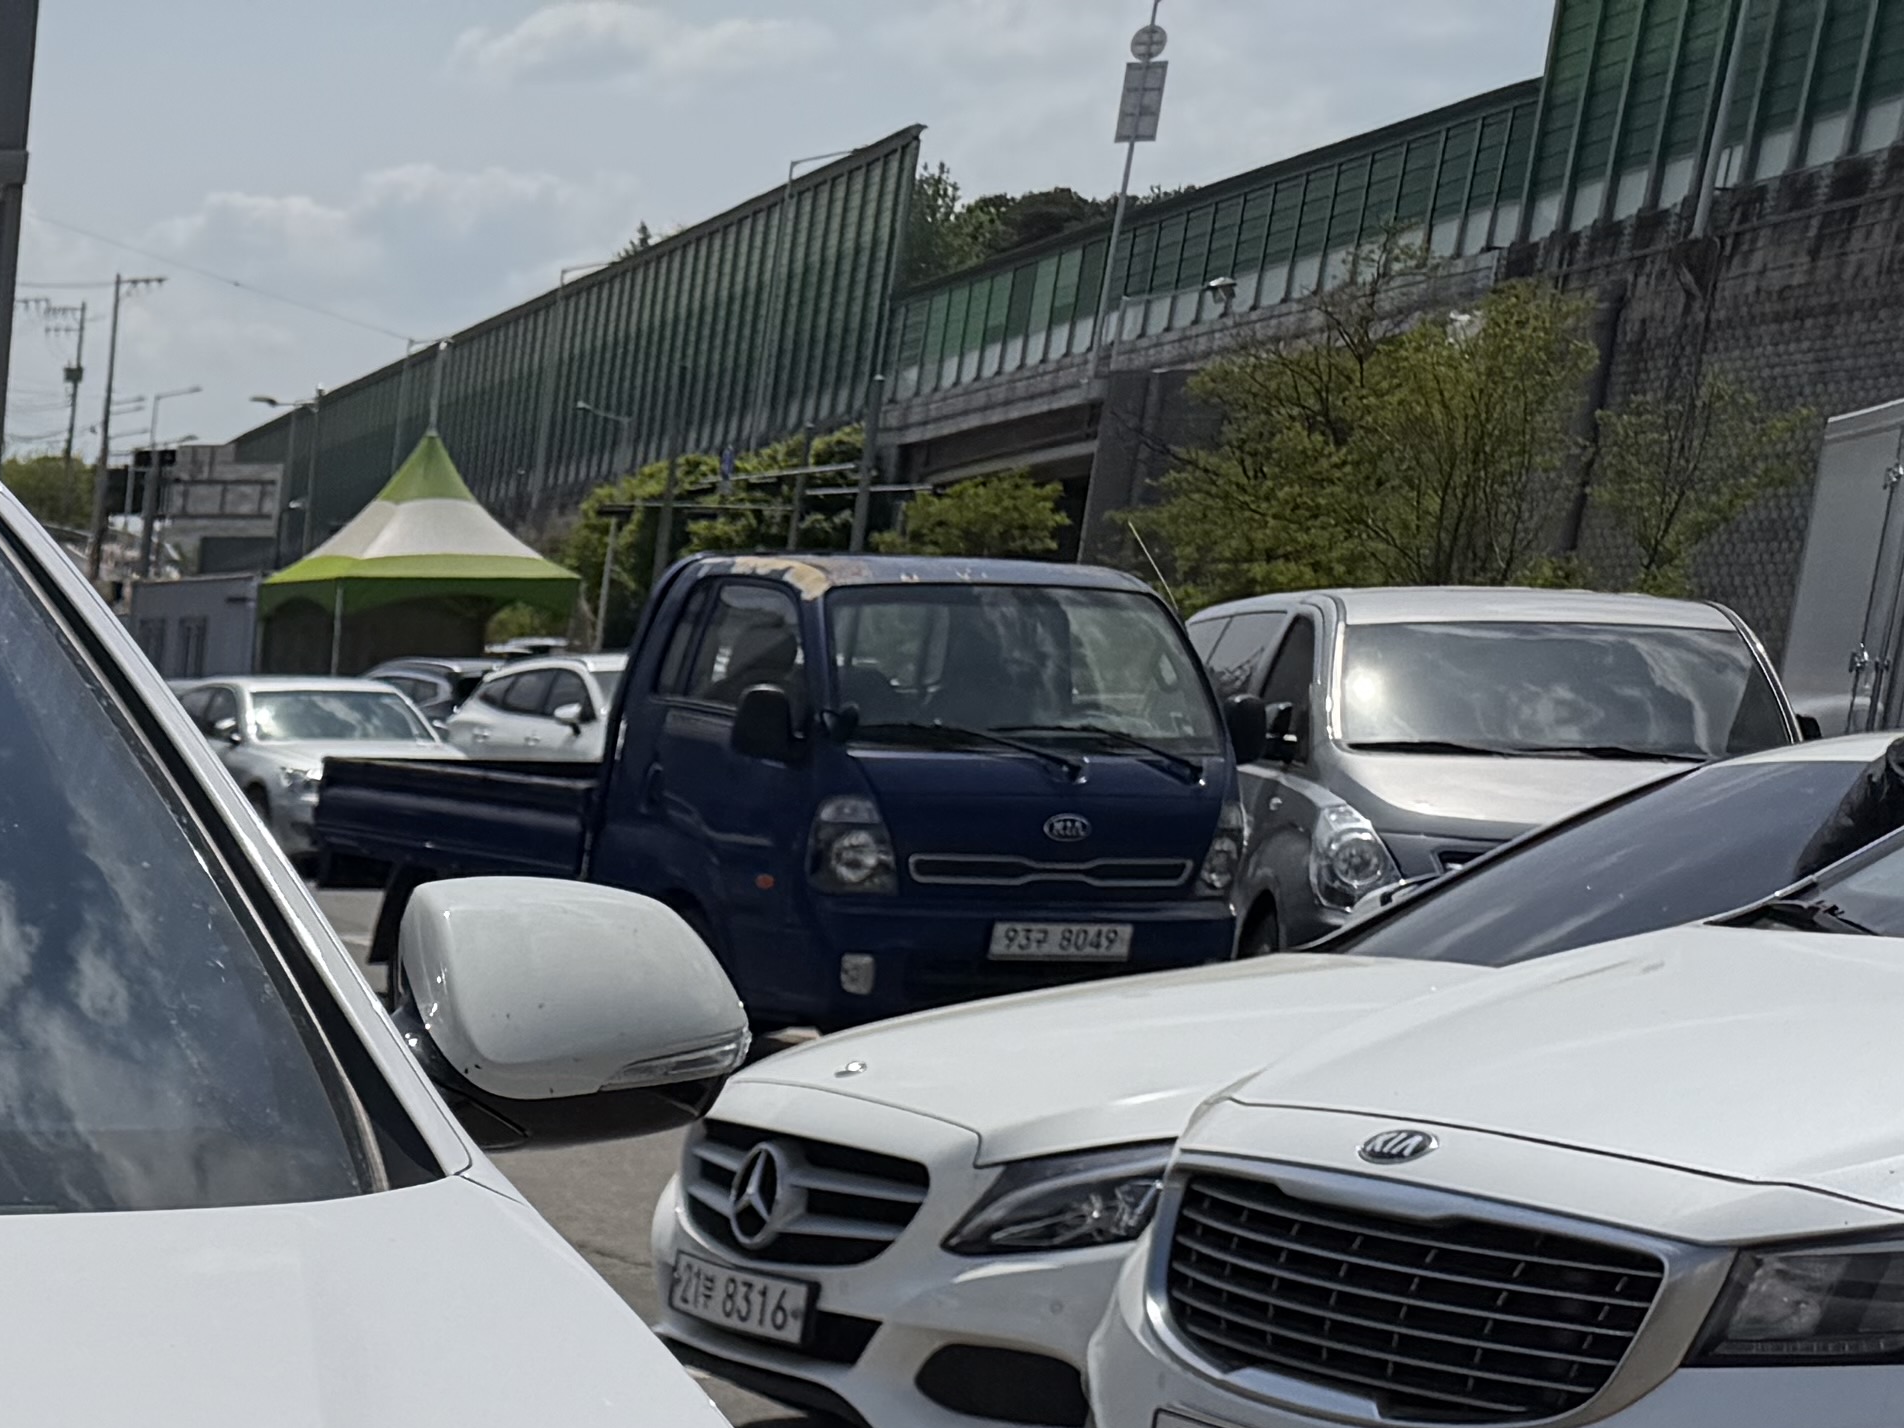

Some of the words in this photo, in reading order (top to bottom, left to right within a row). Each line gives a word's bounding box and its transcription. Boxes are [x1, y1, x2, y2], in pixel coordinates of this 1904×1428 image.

[1059, 927, 1119, 951] 8049
[1366, 1132, 1423, 1157] KIA
[722, 1277, 788, 1331] 8316
